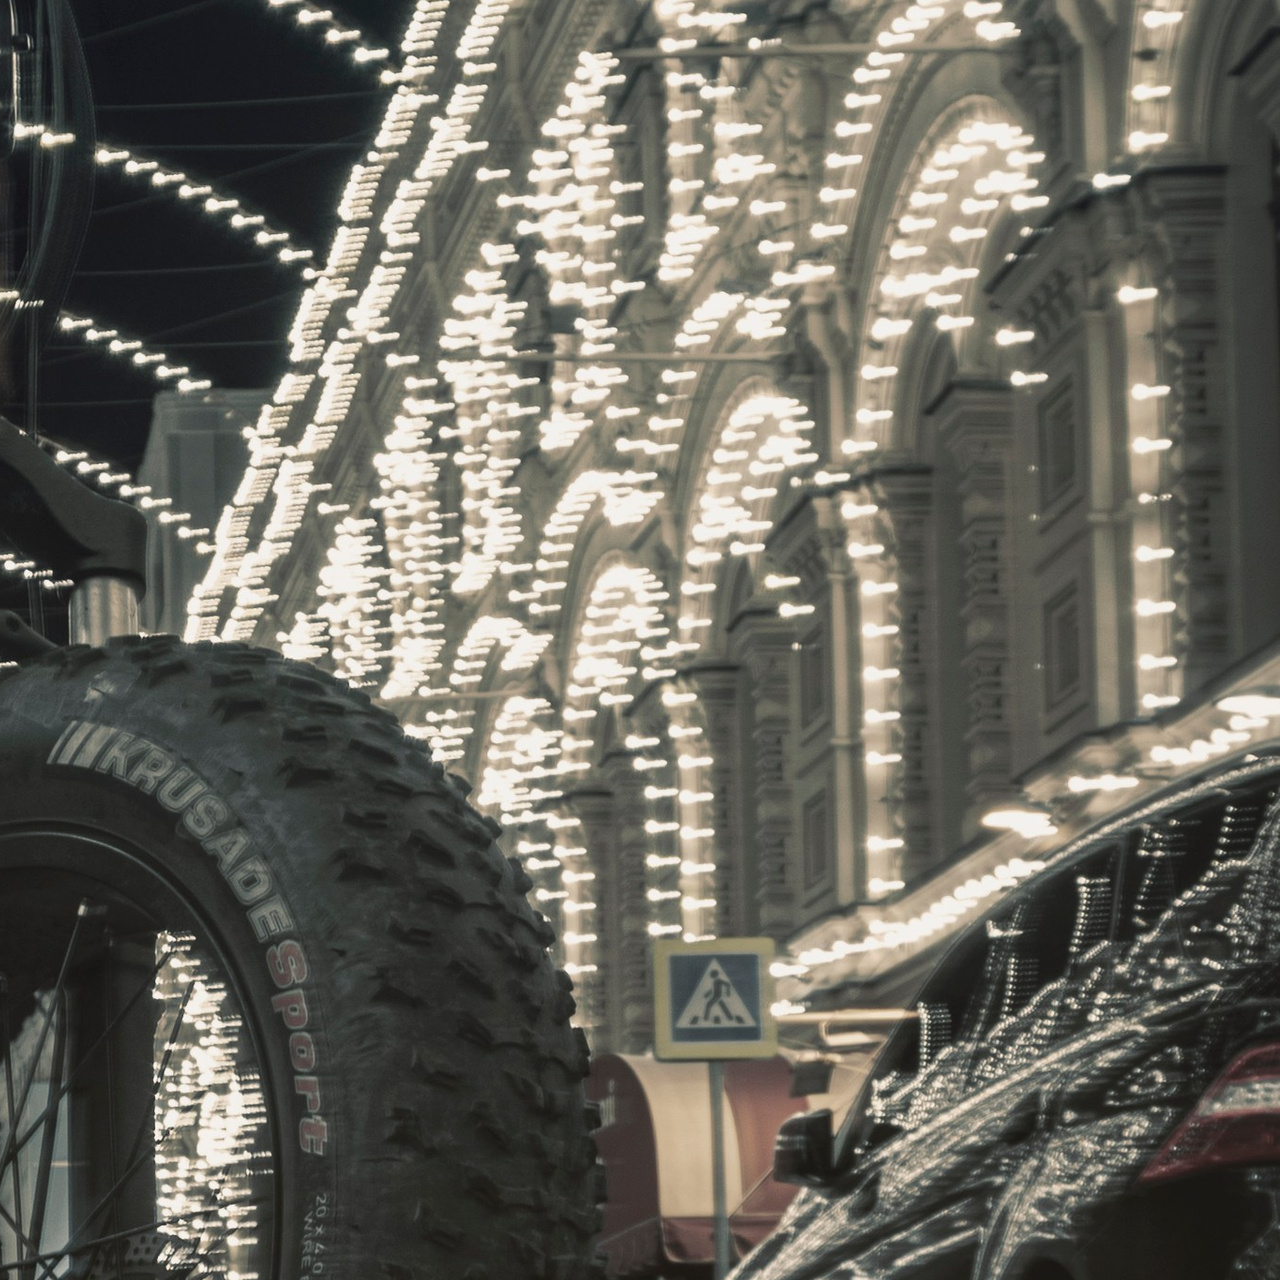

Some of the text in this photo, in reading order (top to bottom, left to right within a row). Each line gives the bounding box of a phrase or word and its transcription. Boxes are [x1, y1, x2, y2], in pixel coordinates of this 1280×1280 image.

[94, 730, 295, 944] KRUSADE
[315, 1192, 328, 1217] 20
[301, 1210, 314, 1269] WIRE
[312, 1242, 325, 1274] 4.0
